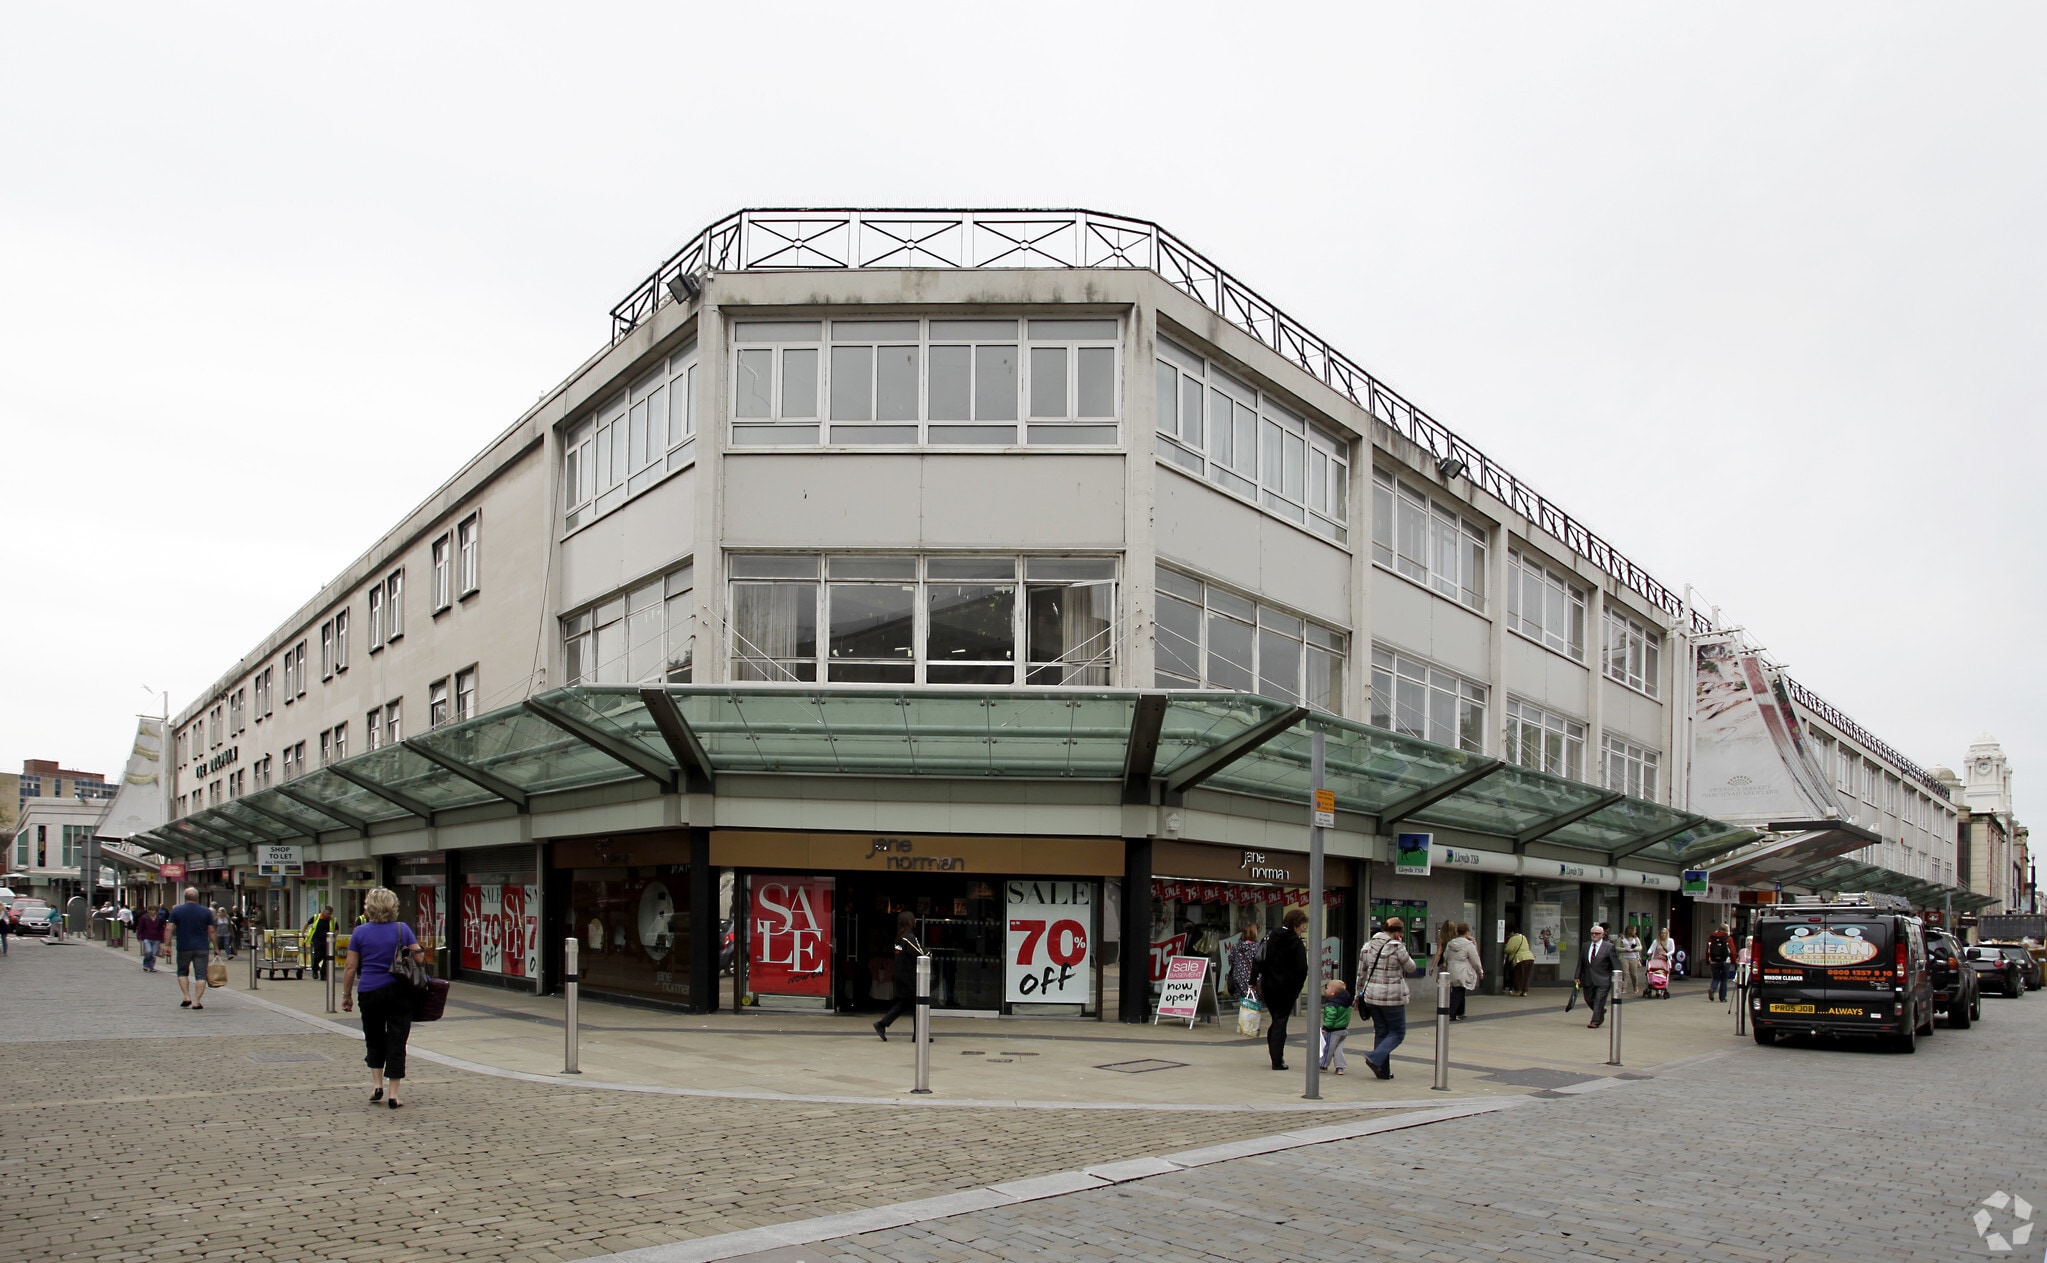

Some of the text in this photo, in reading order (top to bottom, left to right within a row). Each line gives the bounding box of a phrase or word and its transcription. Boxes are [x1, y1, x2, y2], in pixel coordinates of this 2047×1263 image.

[865, 838, 913, 859] jane
[887, 855, 965, 871] norman
[1241, 851, 1265, 869] jane
[1454, 852, 1480, 866] Lloyds TSB
[1252, 867, 1290, 880] norman
[1008, 881, 1090, 905] SALE
[1164, 885, 1180, 898] SALE
[1204, 887, 1219, 900] SALE
[1268, 890, 1281, 903] SALE
[1172, 961, 1199, 972] sale
[1019, 962, 1076, 995] off
[1169, 971, 1202, 979] BASEMENT
[663, 982, 690, 996] norma
[1165, 990, 1197, 1006] open!
[1797, 1005, 1814, 1013] JOB
